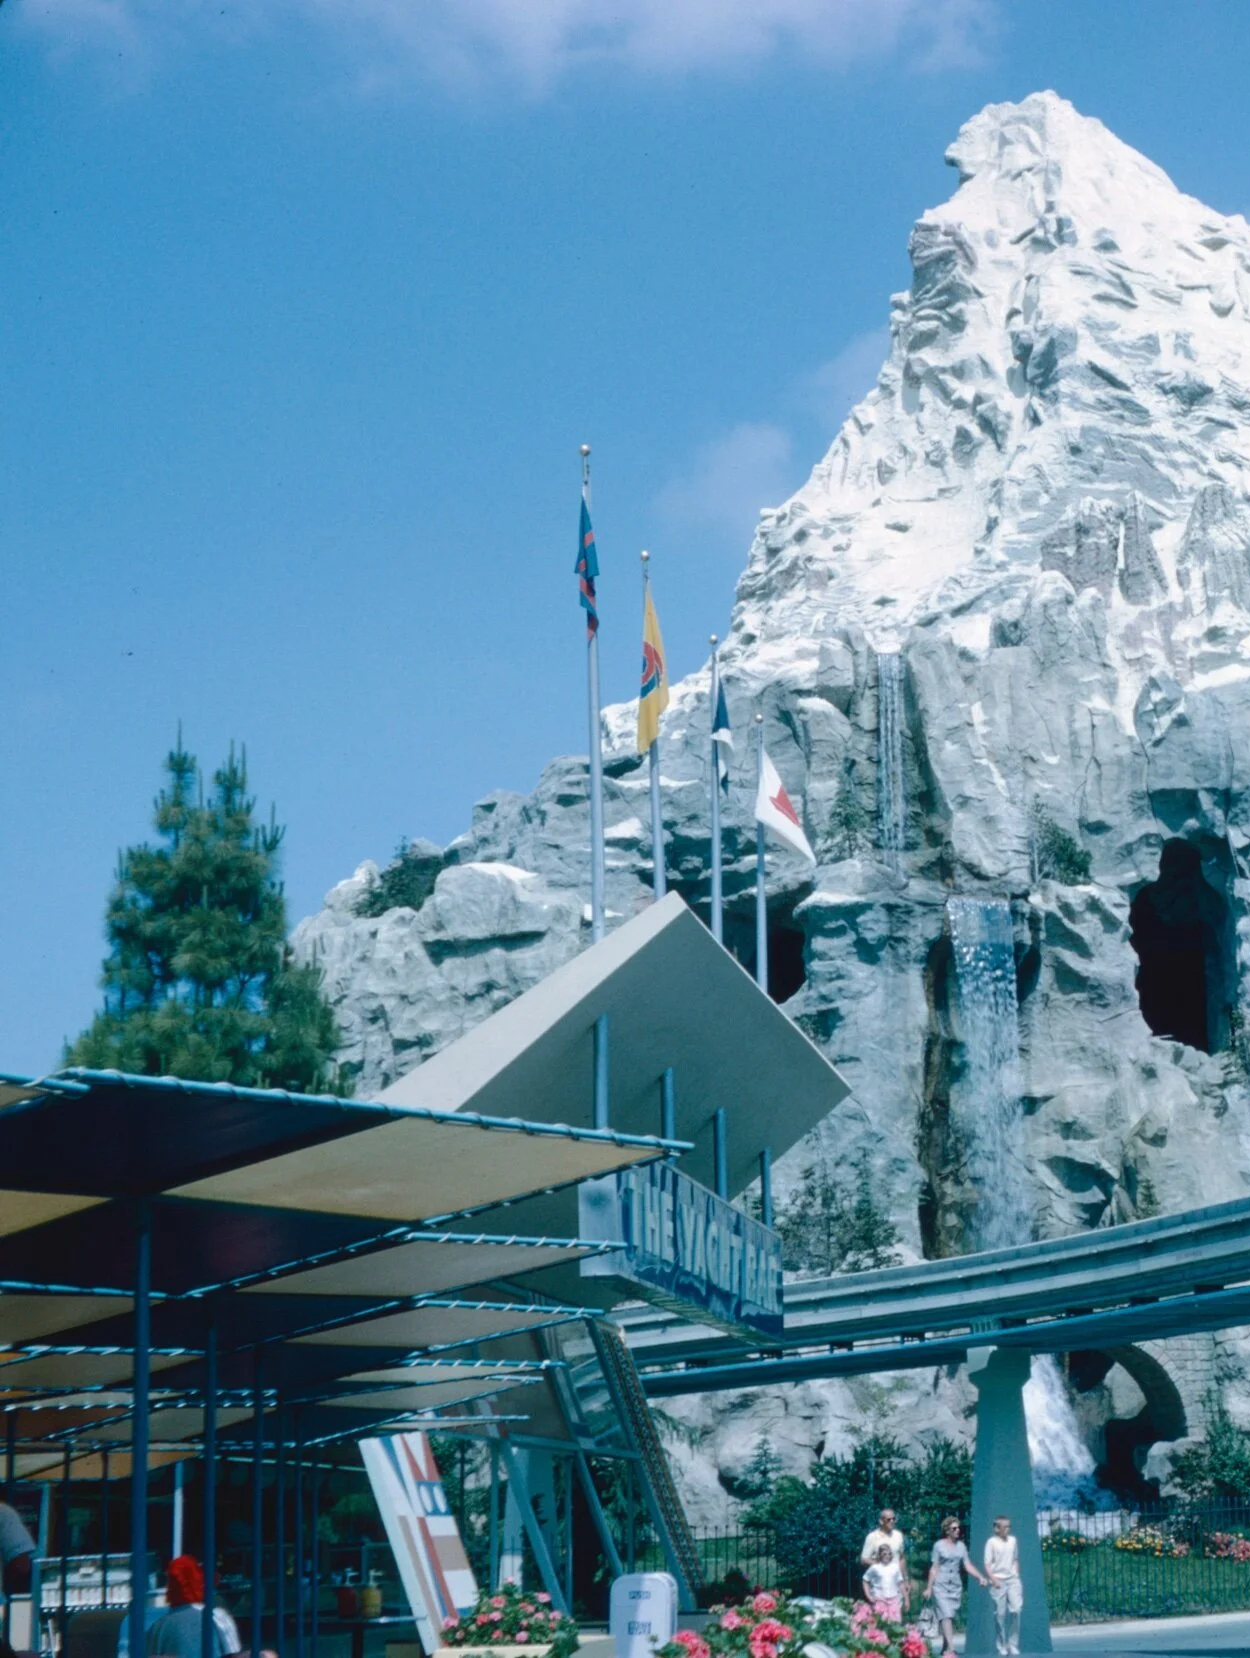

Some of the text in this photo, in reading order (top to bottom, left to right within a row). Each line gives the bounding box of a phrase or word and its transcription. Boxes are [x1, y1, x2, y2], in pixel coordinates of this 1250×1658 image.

[628, 1171, 783, 1315] THE YACHT BAR
